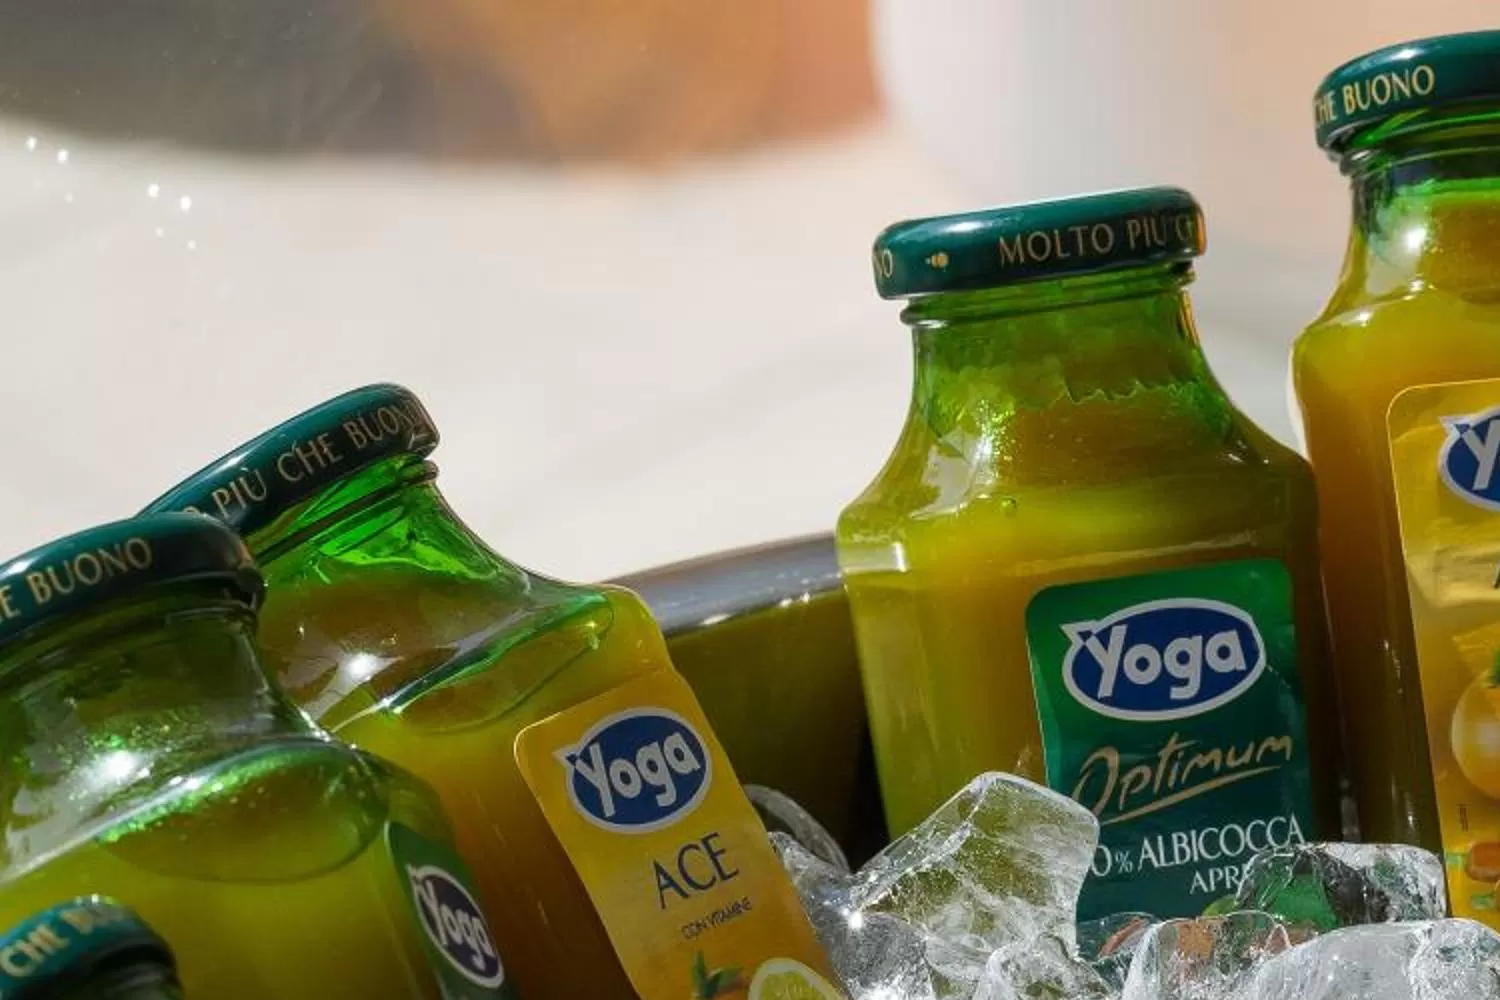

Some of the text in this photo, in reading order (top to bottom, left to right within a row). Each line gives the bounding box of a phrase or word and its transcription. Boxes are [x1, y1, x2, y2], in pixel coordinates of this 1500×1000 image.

[1343, 64, 1435, 115] BUONO
[1000, 222, 1114, 267] MOLTO
[277, 433, 344, 482] CHE
[26, 537, 152, 604] BUONO
[1082, 624, 1247, 700] Yoga
[574, 732, 702, 818] Yoga
[1070, 731, 1293, 822] Optimum
[654, 832, 739, 910] ACE
[1092, 812, 1306, 877] 0% ALBICOCCA
[417, 878, 496, 971] Yoga
